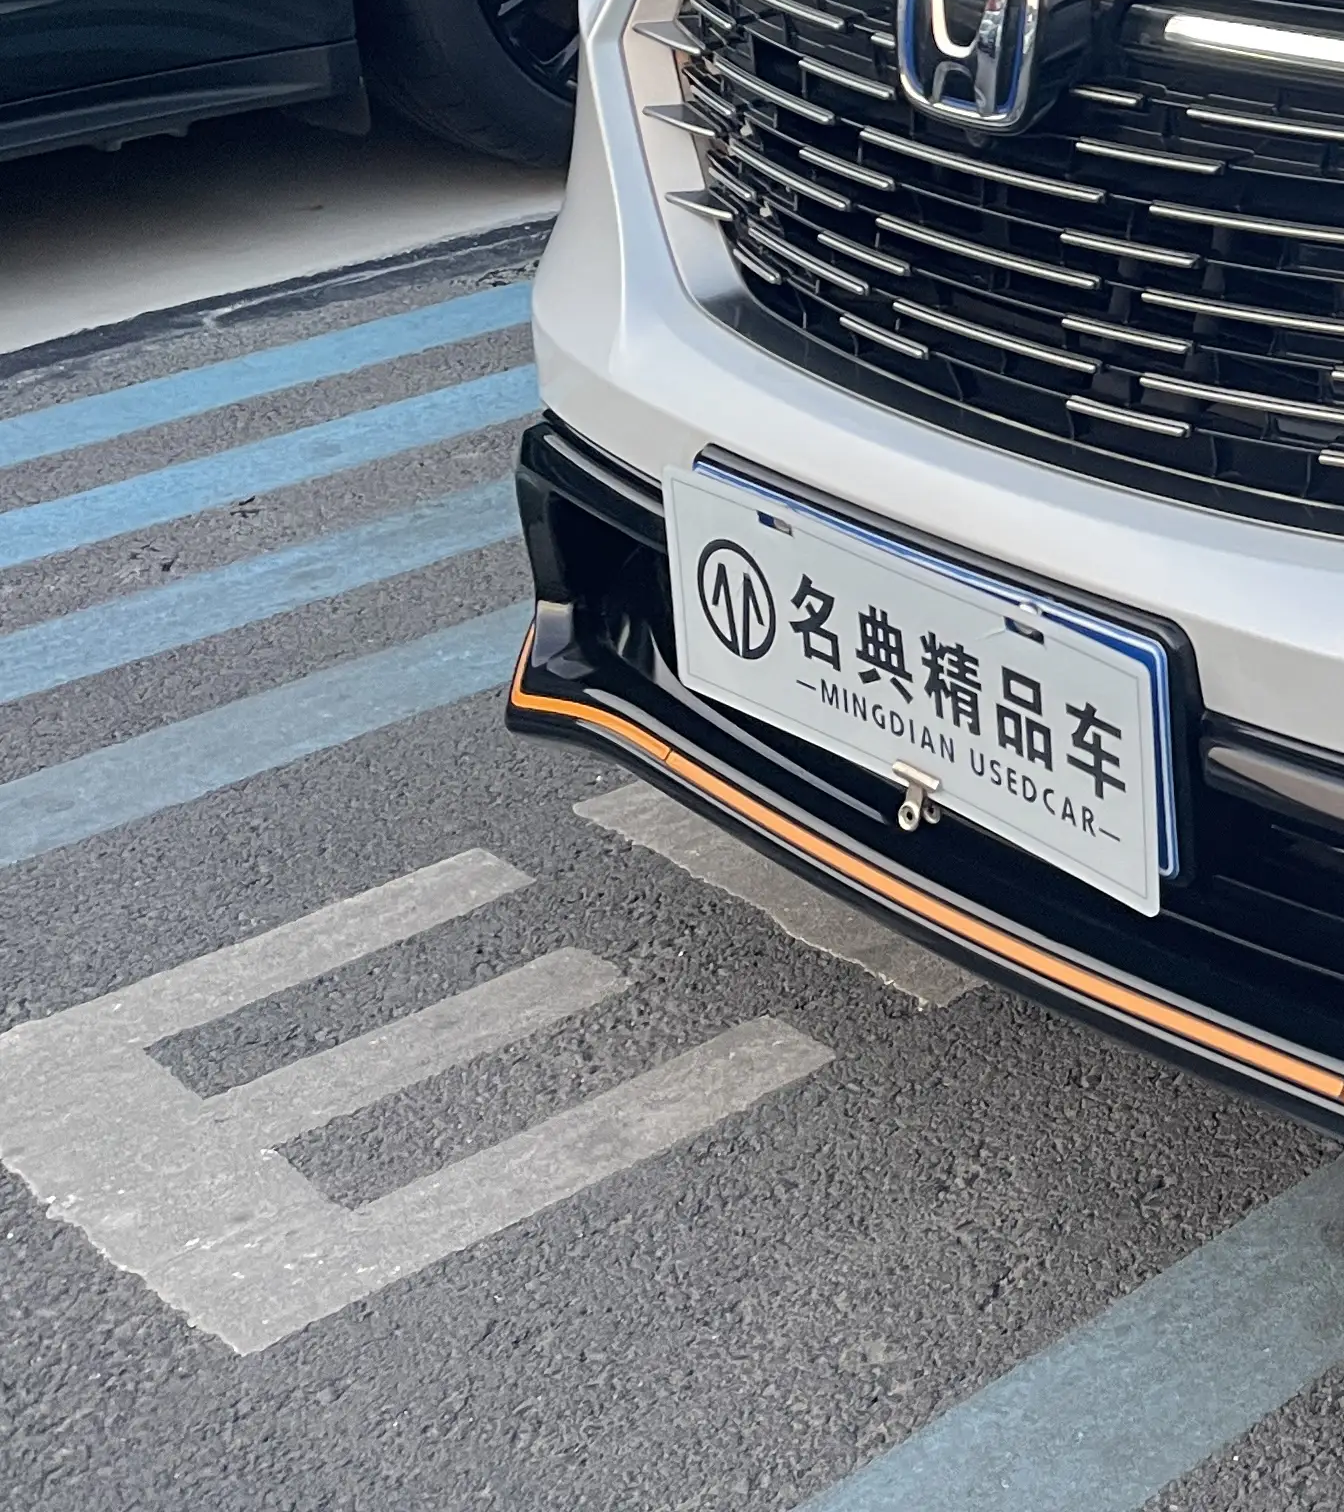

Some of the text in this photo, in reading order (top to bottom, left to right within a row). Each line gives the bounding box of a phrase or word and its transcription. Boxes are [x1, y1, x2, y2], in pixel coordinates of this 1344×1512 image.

[788, 574, 1127, 800] 名典精品车
